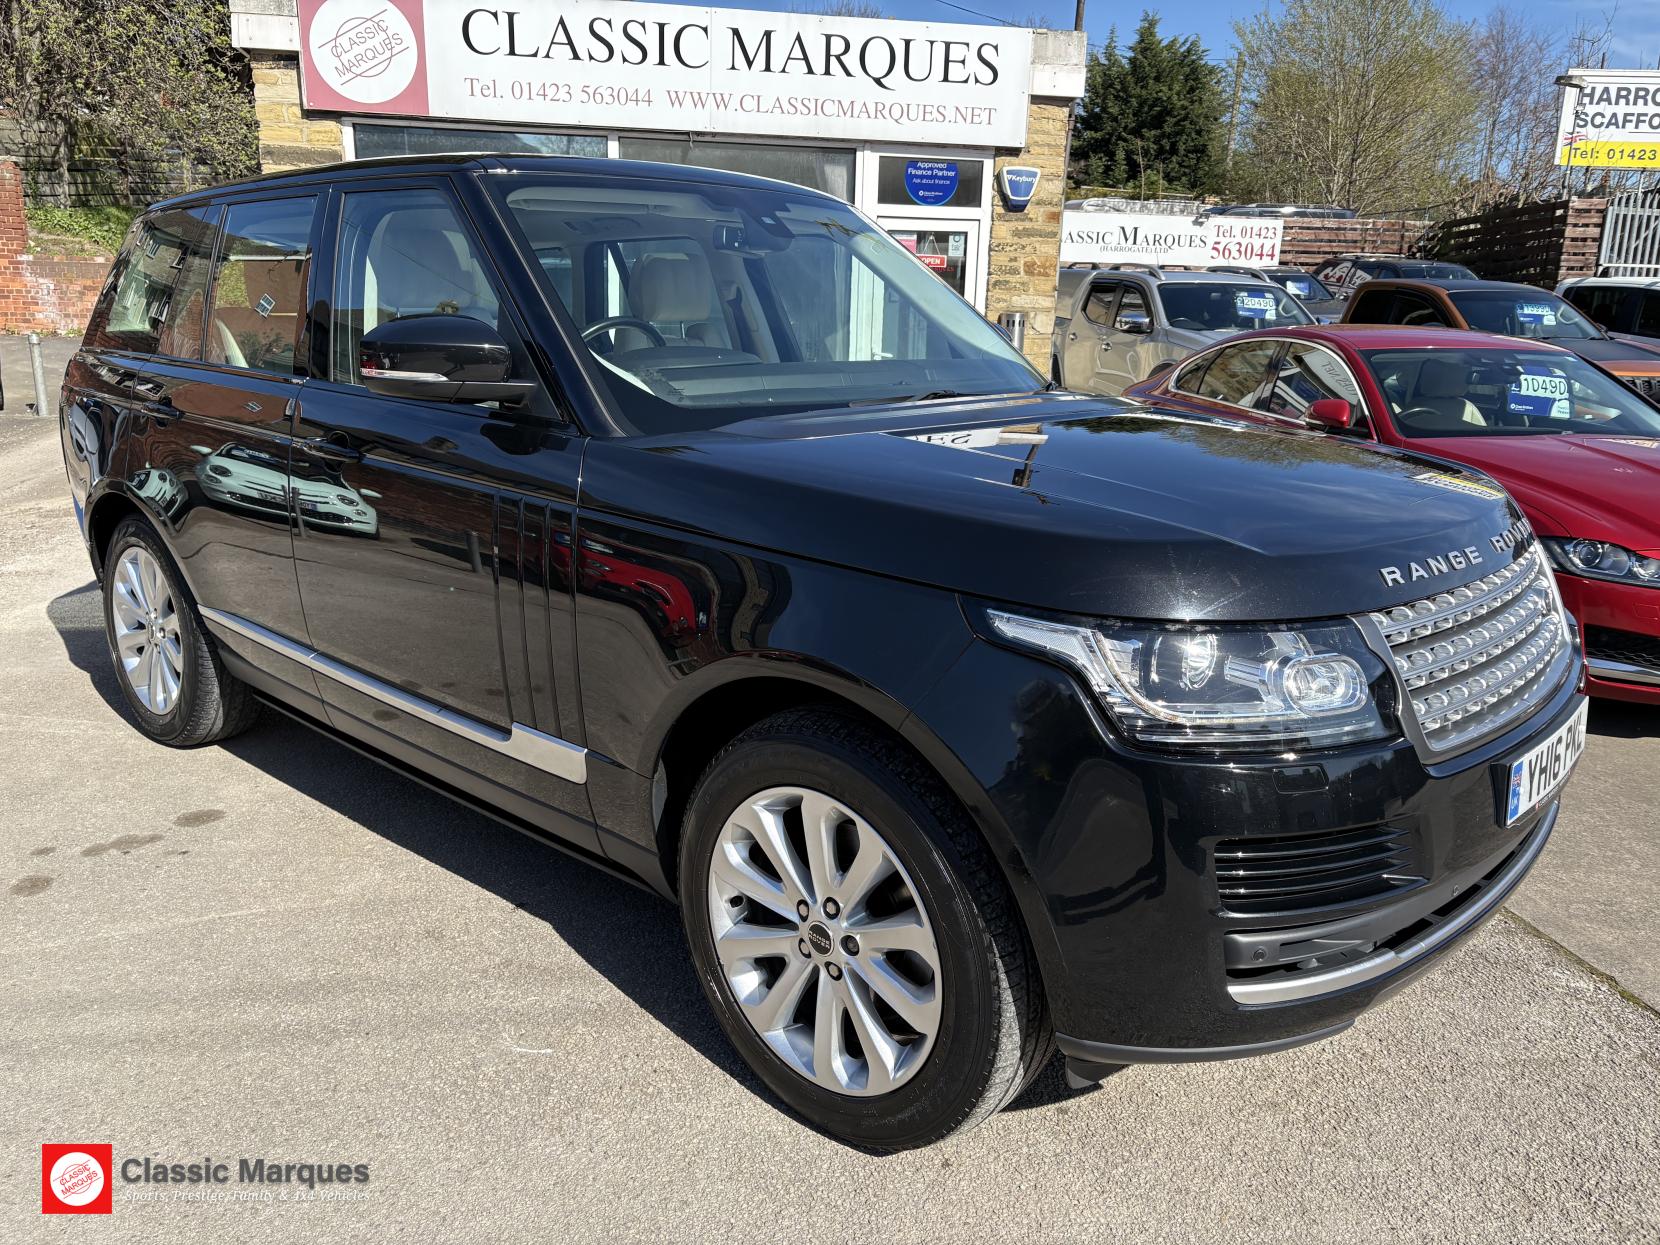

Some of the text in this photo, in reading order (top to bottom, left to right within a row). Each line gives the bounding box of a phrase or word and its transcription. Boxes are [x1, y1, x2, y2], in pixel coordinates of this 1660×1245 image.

[330, 19, 389, 58] CLASSIC
[334, 32, 404, 78] MARQUES
[462, 8, 1000, 91] CLASSIC MARQUES
[465, 77, 997, 126] Tel. 01423 563044 WWW.CLASSICMARQUES.NET
[1572, 147, 1658, 161] Tel: 01423
[908, 168, 956, 177] Finance Partner
[917, 161, 947, 169] Approved
[1012, 175, 1036, 183] Keybury
[1064, 226, 1207, 251] ASSIC MARQUES
[1213, 224, 1277, 240] Tel. 01423
[1154, 246, 1169, 254] LTD
[1210, 240, 1276, 261] 563044
[921, 257, 941, 265] OPEN
[1379, 546, 1483, 588] RANGE
[1528, 735, 1563, 802] YH16
